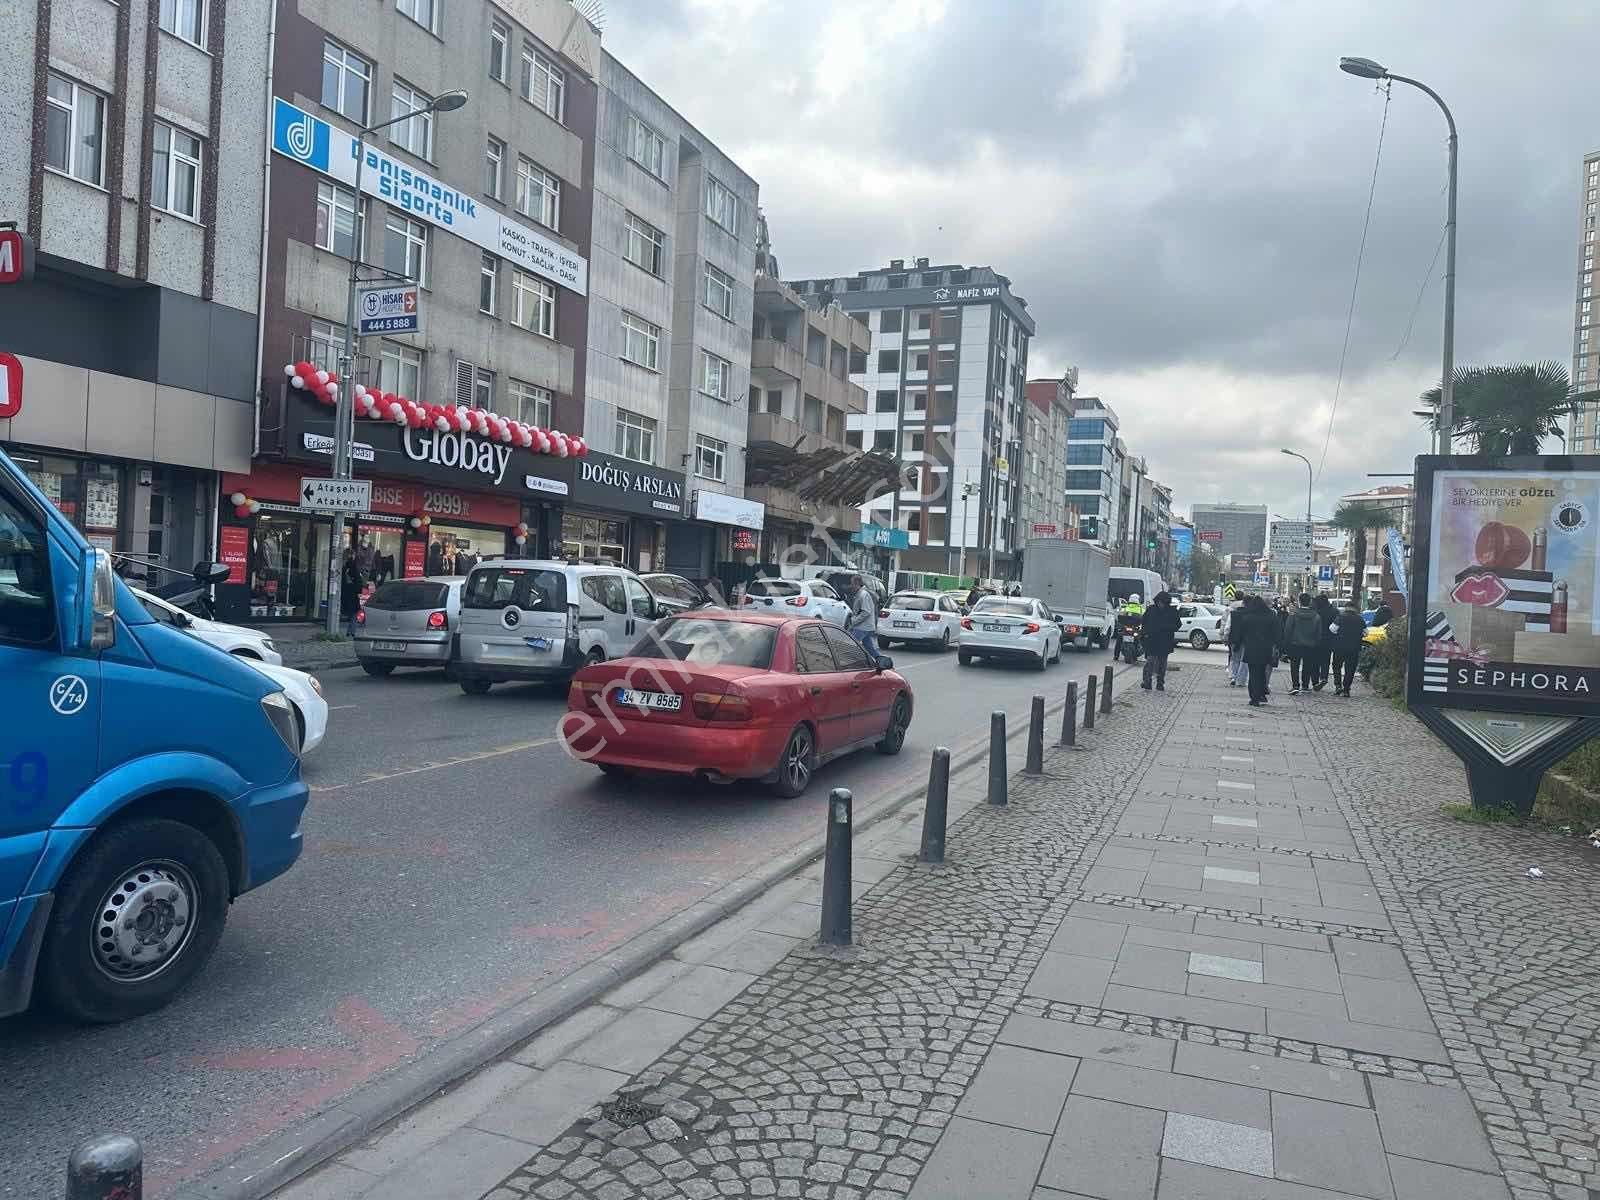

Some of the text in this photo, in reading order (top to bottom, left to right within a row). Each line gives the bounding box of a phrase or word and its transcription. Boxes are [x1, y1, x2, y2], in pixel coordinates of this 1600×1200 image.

[380, 175, 453, 225] Sigorta
[502, 226, 526, 244] KASKO
[531, 241, 555, 260] TRAFİK
[502, 240, 526, 258] KONUT
[560, 269, 577, 283] DASK
[382, 291, 404, 305] HİSAR
[957, 287, 1000, 298] NAFİZ YAPI
[368, 318, 410, 330] 444 5 888
[403, 425, 513, 485] Globay
[581, 461, 630, 492] DOĞUŞ
[633, 475, 681, 498] ARSLAN
[316, 497, 361, 507] Atakent
[423, 489, 461, 515] 2999
[1505, 498, 1522, 507] VER
[1519, 487, 1556, 498] GÜZEL
[1458, 668, 1590, 693] SEPHORA
[624, 691, 680, 708] 34 ZV 8585
